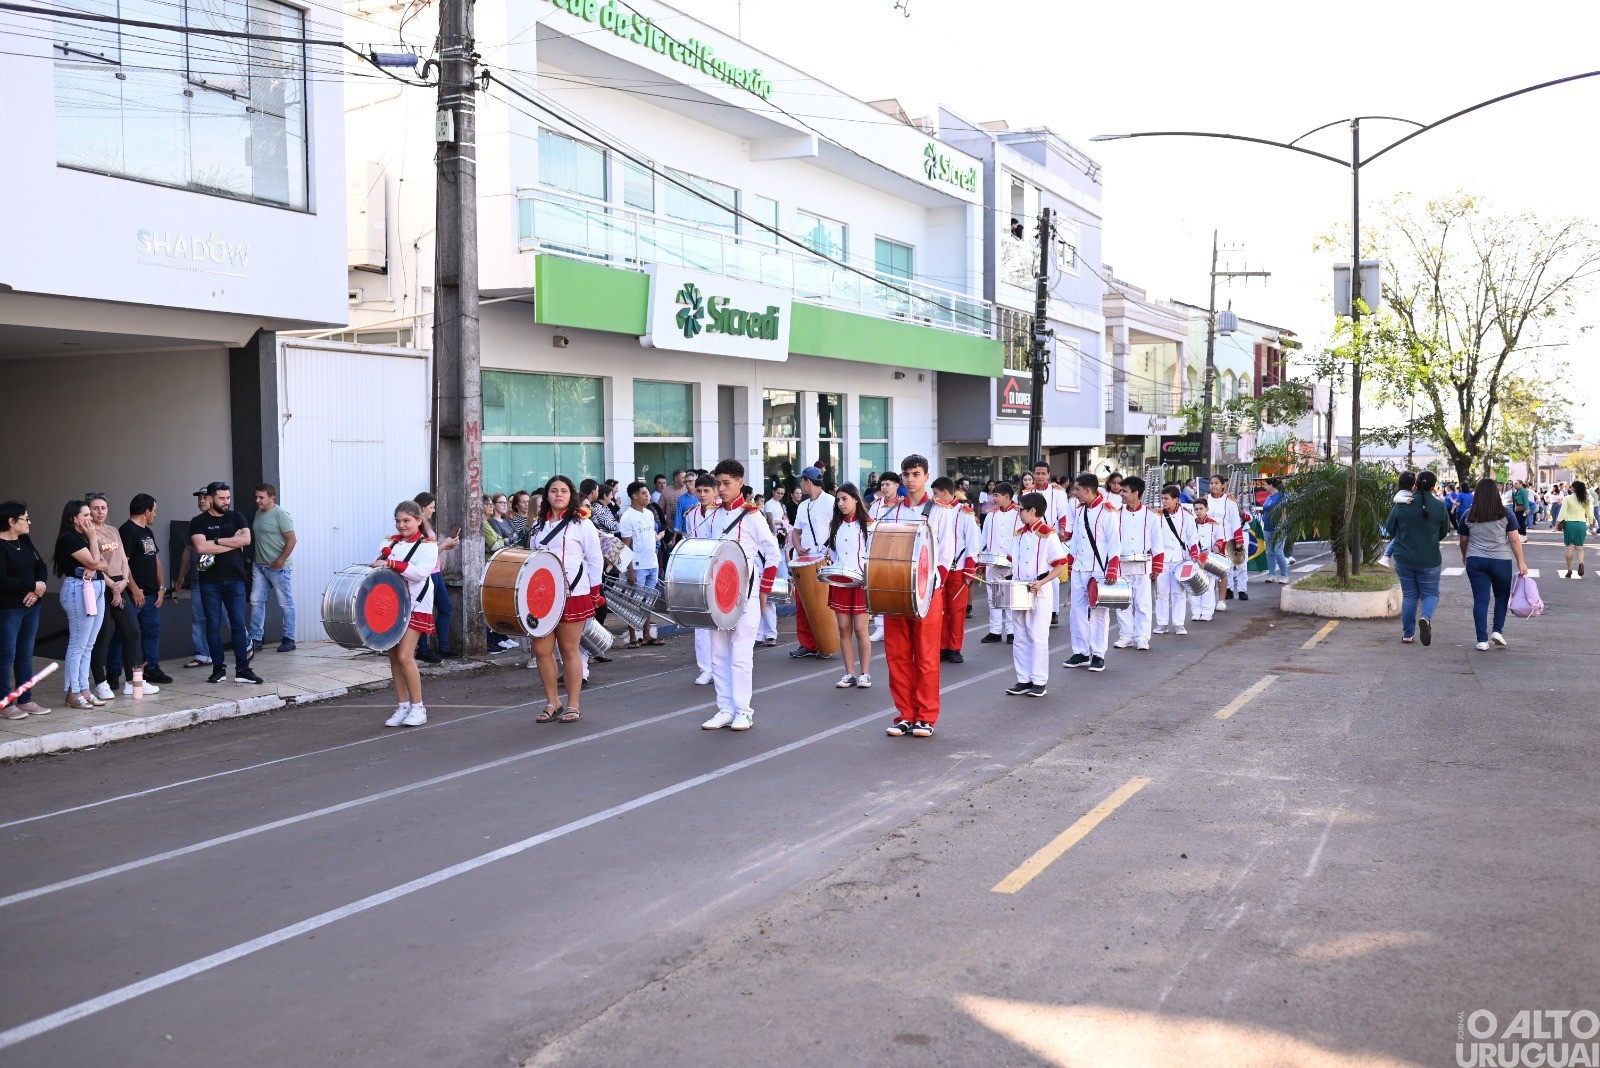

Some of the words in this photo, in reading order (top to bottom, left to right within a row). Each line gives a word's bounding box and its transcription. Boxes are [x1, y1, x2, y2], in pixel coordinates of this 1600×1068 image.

[600, 0, 630, 38] da
[630, 14, 701, 68] Sicredi
[701, 46, 774, 99] Conexão
[939, 155, 977, 193] Sicredi
[137, 228, 251, 269] SHADOW
[706, 296, 780, 341] Sicredi
